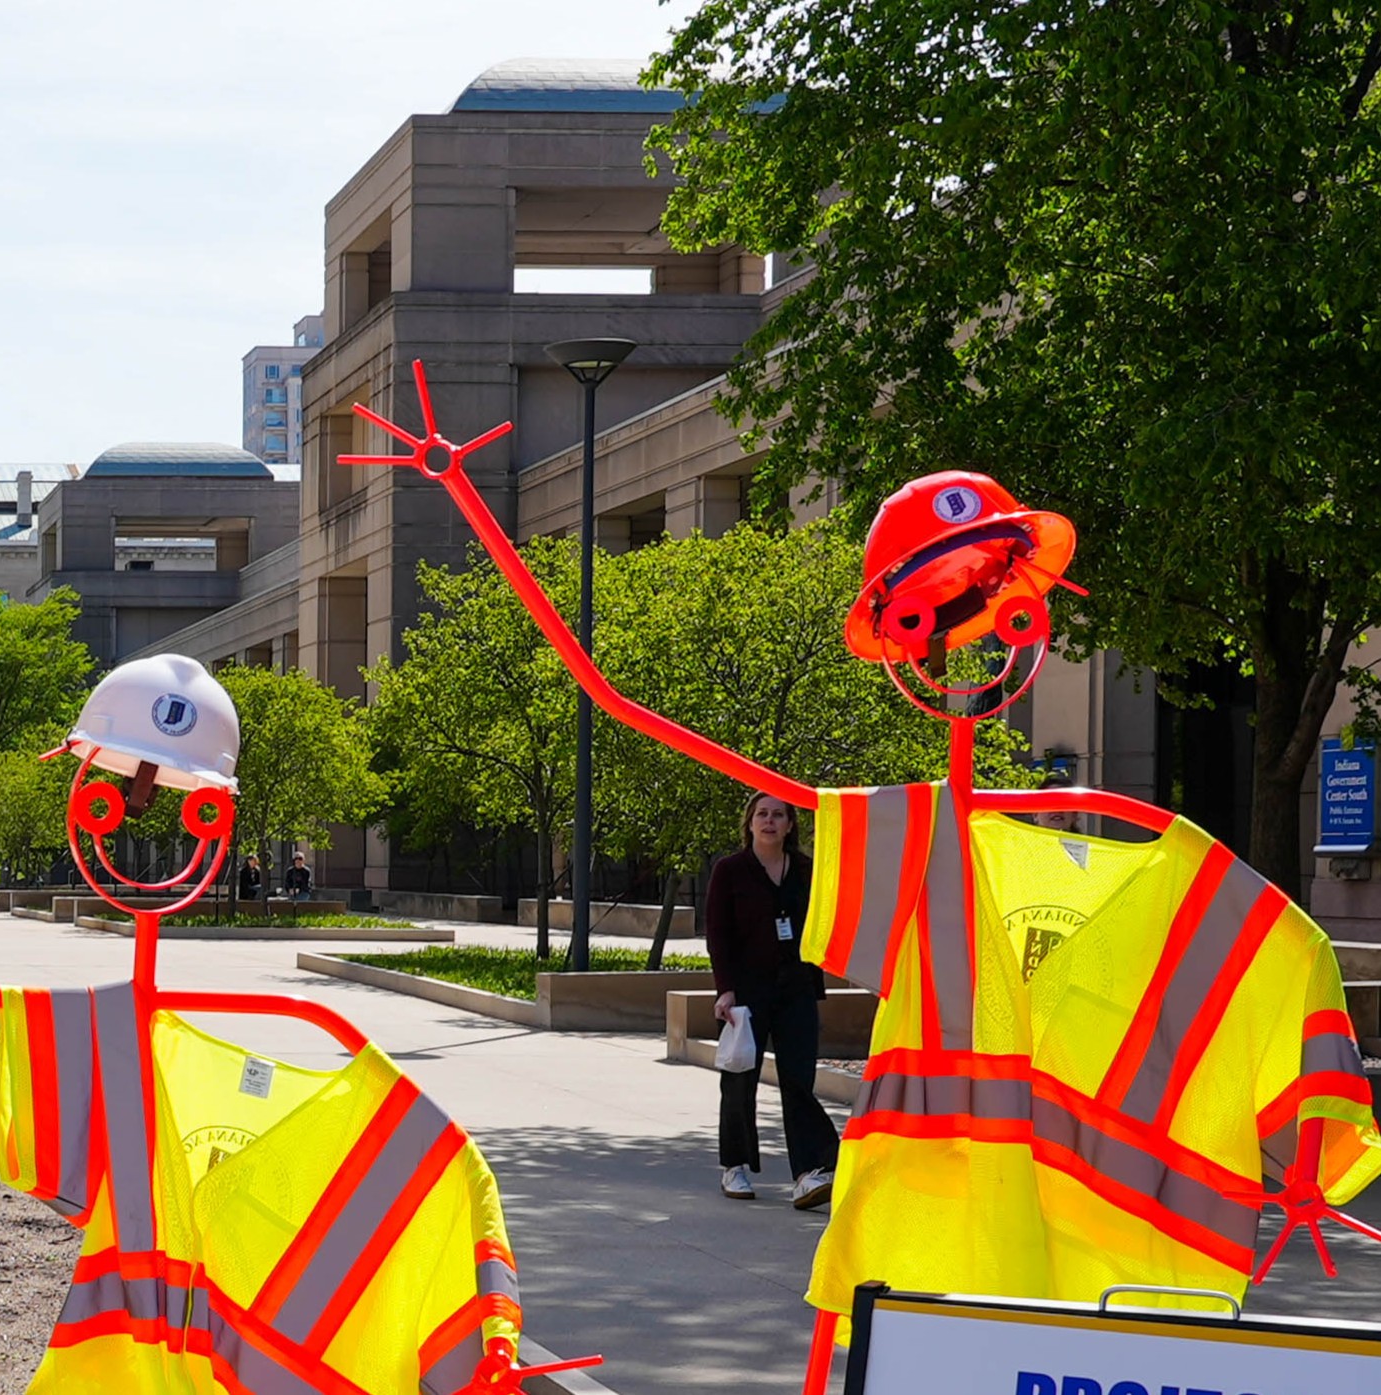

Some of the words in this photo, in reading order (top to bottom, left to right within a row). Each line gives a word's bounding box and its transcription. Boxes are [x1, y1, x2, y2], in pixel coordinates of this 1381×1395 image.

[1334, 758, 1360, 771] Indiana
[1326, 774, 1367, 786] Government
[1326, 790, 1348, 802] Center
[1348, 788, 1368, 801] South
